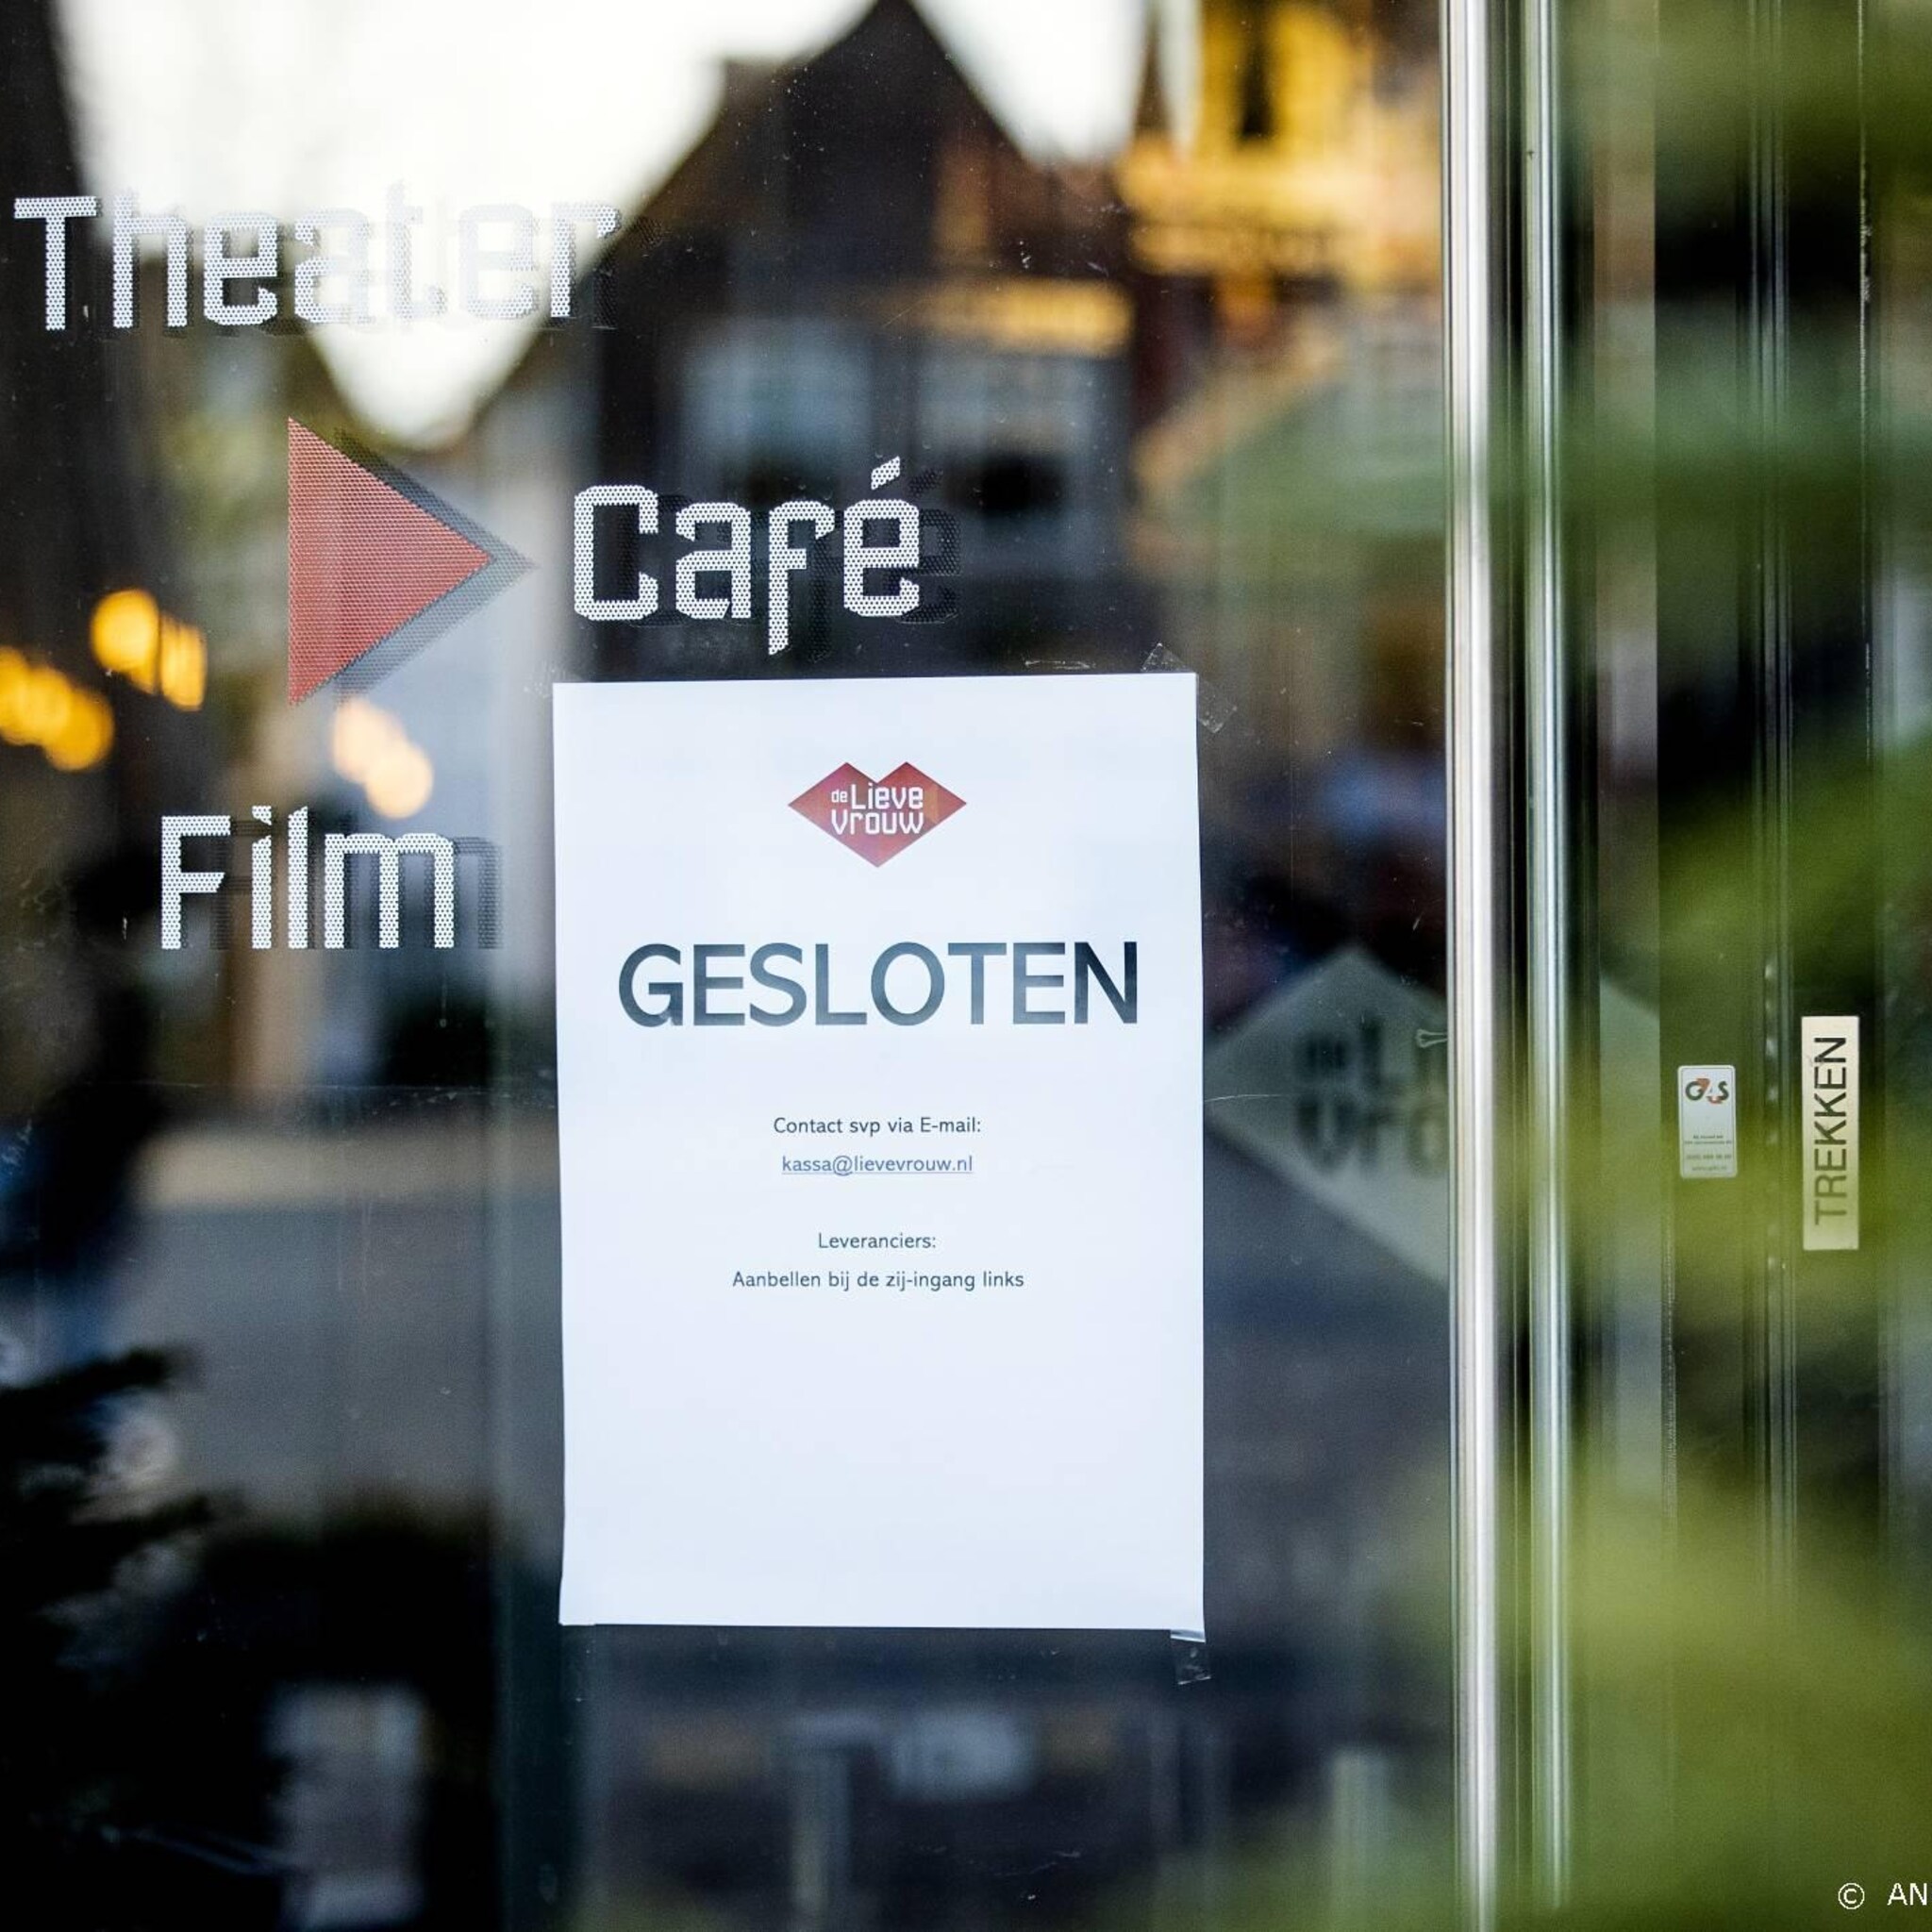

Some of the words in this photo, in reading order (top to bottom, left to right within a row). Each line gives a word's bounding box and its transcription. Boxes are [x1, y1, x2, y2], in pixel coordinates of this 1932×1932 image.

[13, 186, 620, 331] Theater
[574, 457, 921, 656] Café
[831, 789, 848, 803] de
[851, 783, 924, 809] Lieve
[161, 805, 455, 950] Film
[619, 941, 1138, 1027] GESLOTEN
[774, 1117, 843, 1134] Contact
[849, 1120, 881, 1138] svp
[889, 1117, 913, 1133] via
[921, 1116, 982, 1133] E-mail:
[1813, 1036, 1848, 1226] TREKKEN
[782, 1155, 974, 1176] kassa@lievevrouw.nl
[818, 1232, 937, 1249] Leveranciers:
[732, 1271, 821, 1288] Aanbellen
[828, 1271, 850, 1291] bij
[857, 1271, 879, 1287] de
[885, 1271, 975, 1291] zij-ingang
[983, 1271, 1024, 1287] links
